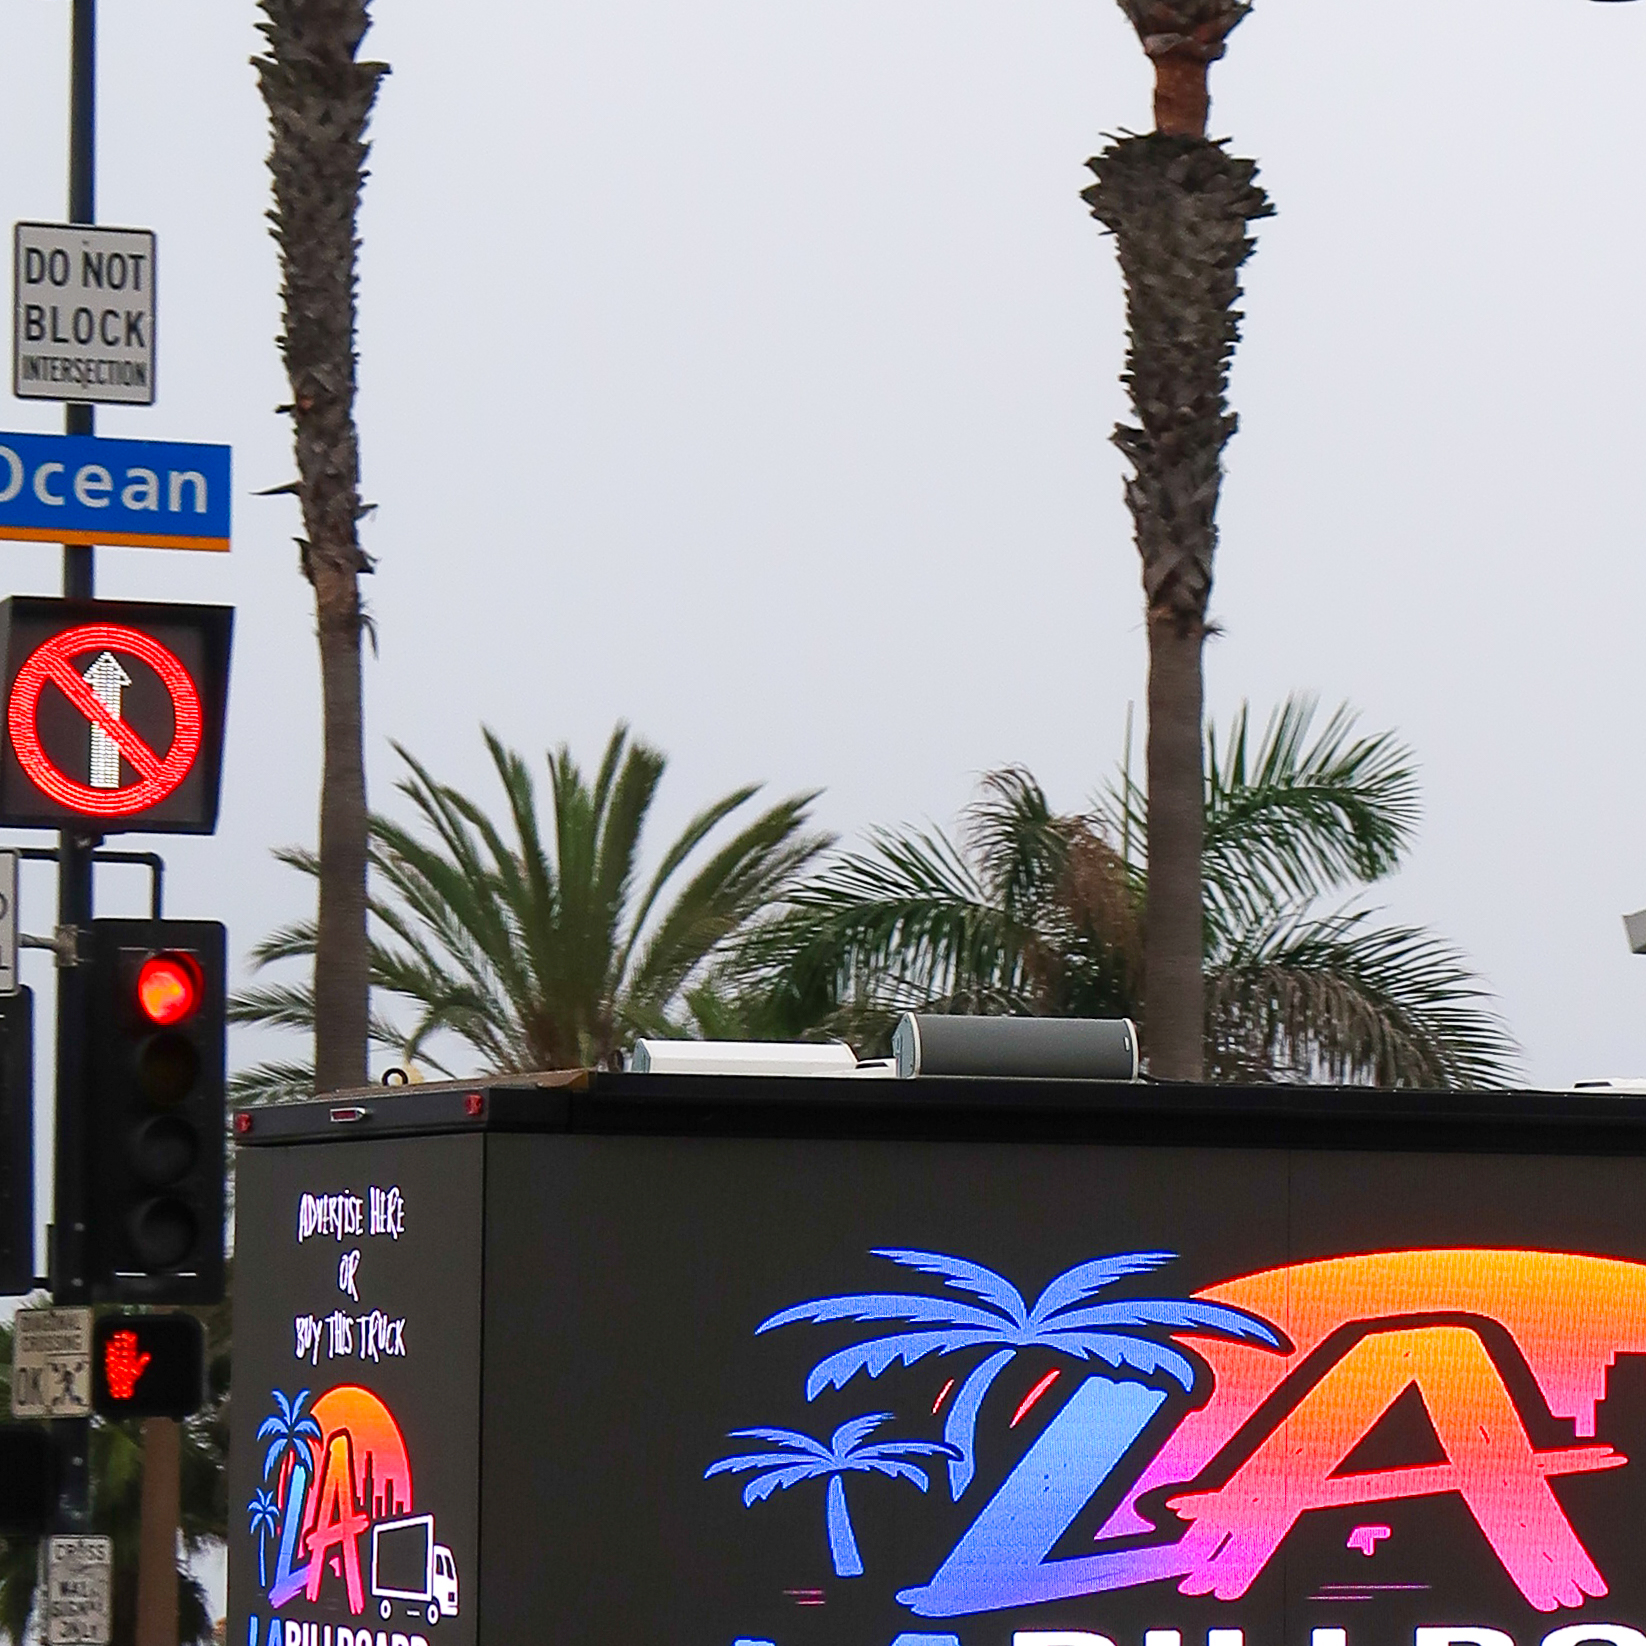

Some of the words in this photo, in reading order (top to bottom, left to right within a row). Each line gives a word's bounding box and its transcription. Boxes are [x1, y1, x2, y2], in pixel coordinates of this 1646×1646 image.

[25, 247, 70, 287] DO
[82, 250, 146, 291] NOT
[25, 304, 145, 348] BLOCK
[22, 355, 147, 387] INTERSECTION
[298, 1188, 364, 1243] ADVERTISE
[369, 1186, 405, 1240] HERE
[339, 1249, 361, 1302] OR
[295, 1314, 323, 1366] BUY
[324, 1310, 354, 1359] THIS
[356, 1309, 406, 1363] TRUCK
